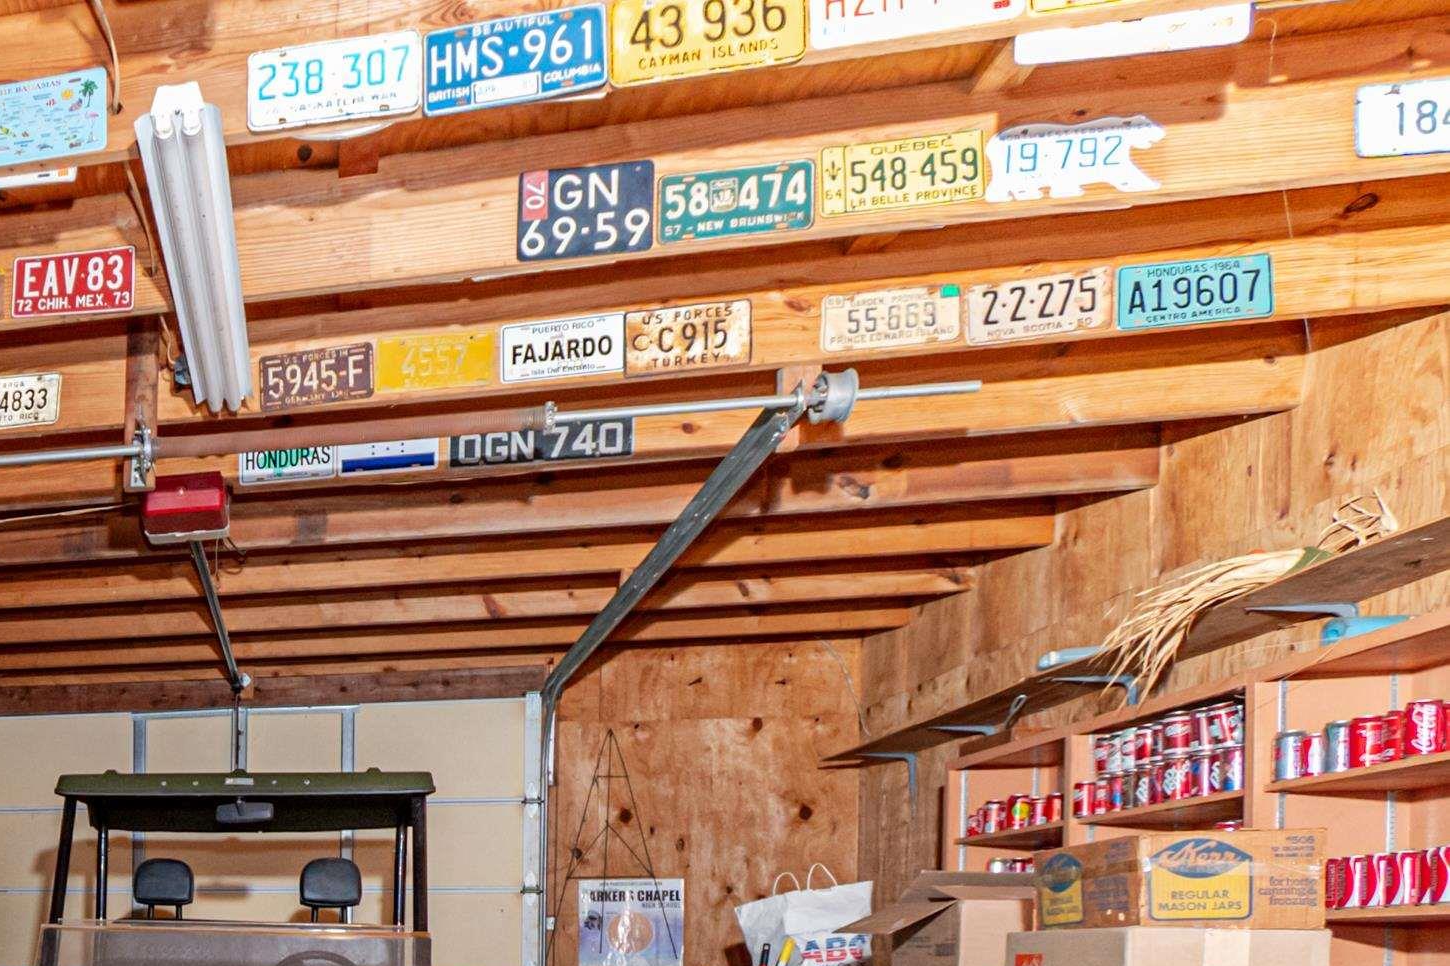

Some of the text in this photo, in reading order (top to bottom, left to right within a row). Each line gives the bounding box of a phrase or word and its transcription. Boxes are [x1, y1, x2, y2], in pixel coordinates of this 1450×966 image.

[472, 16, 554, 37] BEAUTIFUL
[630, 4, 684, 53] 43
[638, 38, 779, 70] CAYMAN ISLANDS
[258, 44, 410, 101] 238 307
[428, 64, 602, 102] BRITISH COLUMBIA
[553, 168, 619, 211] GN
[665, 182, 709, 220] 58
[738, 169, 808, 211] 474
[871, 193, 909, 206] BELLE
[916, 185, 978, 200] PROVINCE
[697, 219, 724, 233] NEW
[16, 299, 33, 312] 72
[113, 291, 130, 304] 73
[1128, 269, 1262, 315] A19607
[1189, 306, 1242, 320] AMERICA
[532, 319, 595, 335] PUERTO RICO
[512, 335, 613, 365] FAJARDO
[651, 351, 721, 369] TURKEY
[551, 421, 624, 459] 740
[244, 445, 331, 471] HONDURAS
[637, 889, 681, 902] CHAPEL
[1158, 900, 1242, 911] MASON JARS
[1170, 889, 1230, 899] REGULAR
